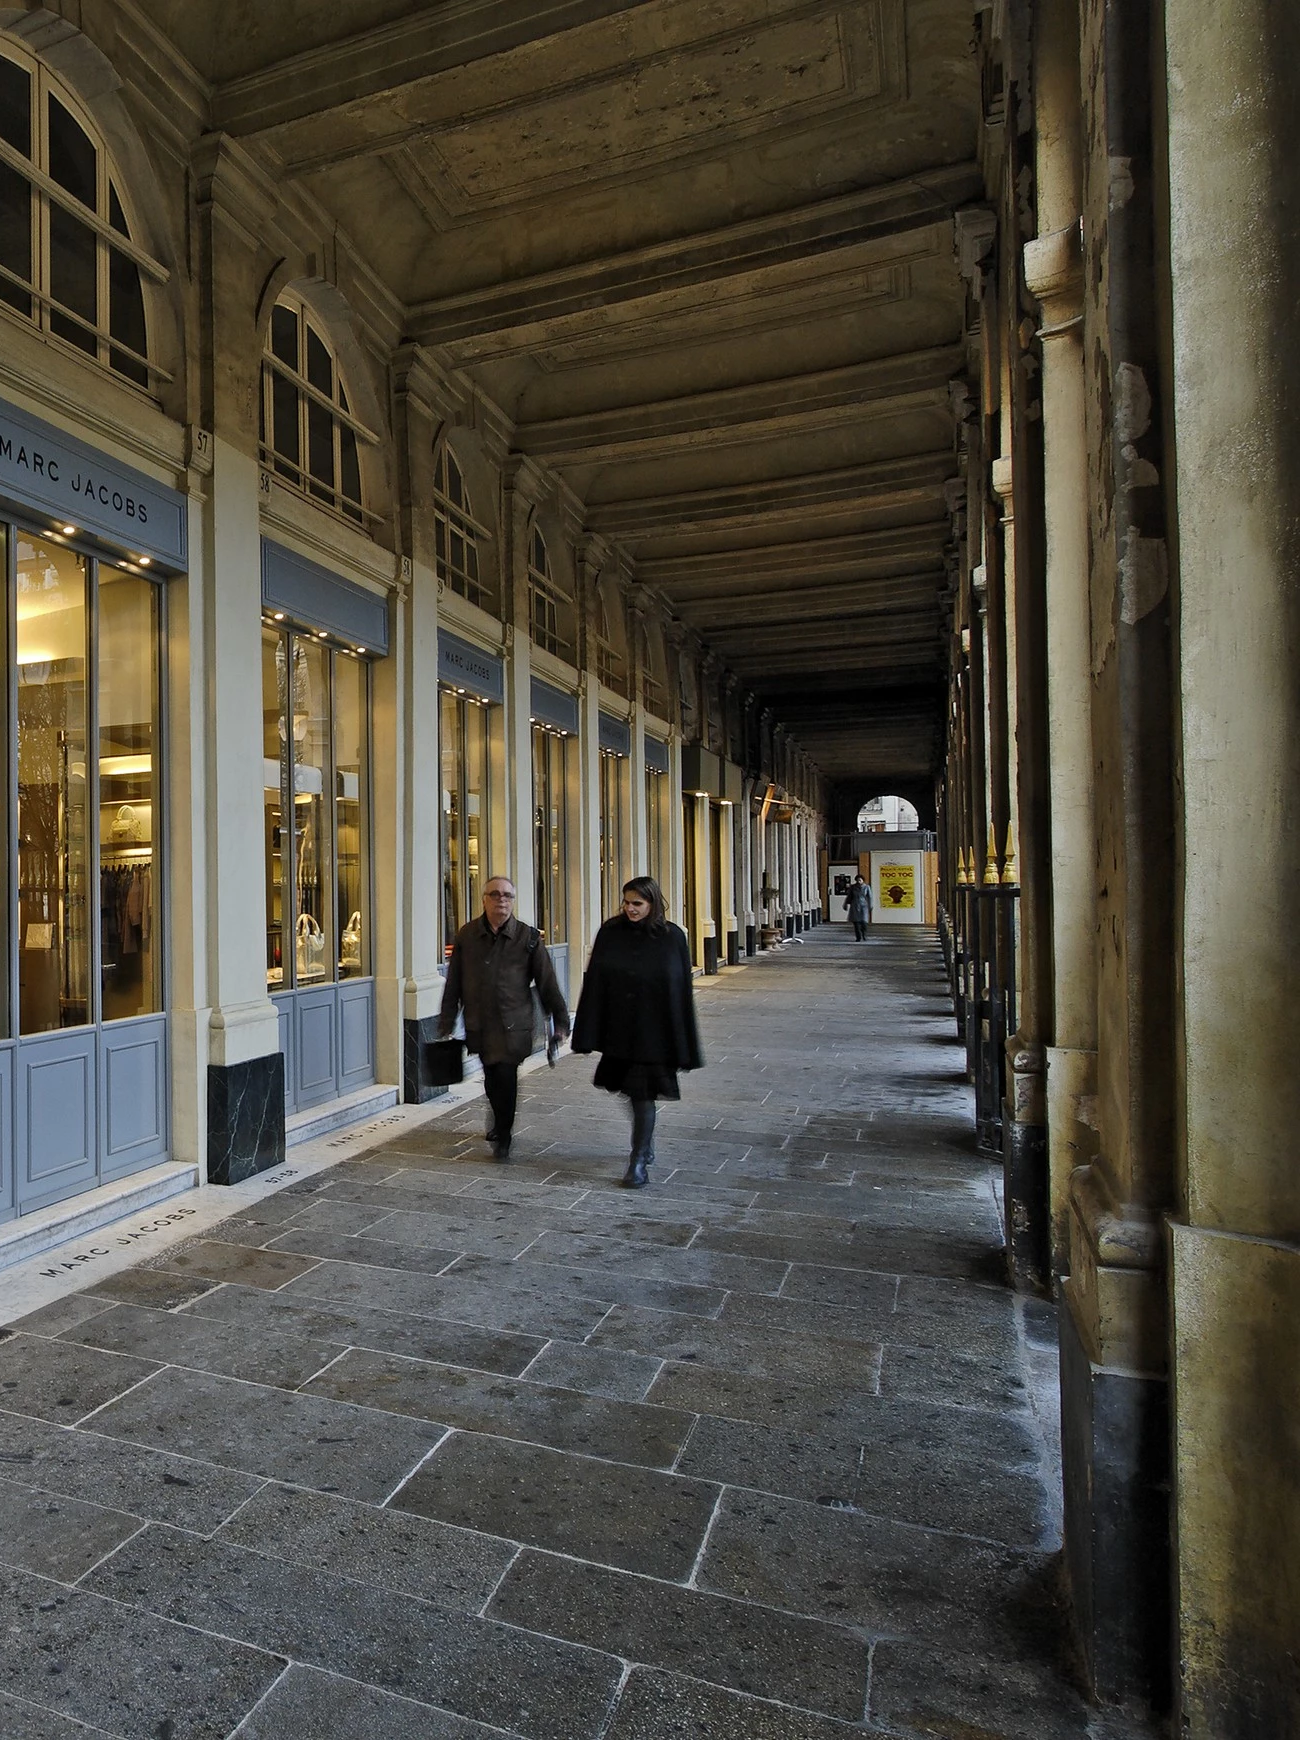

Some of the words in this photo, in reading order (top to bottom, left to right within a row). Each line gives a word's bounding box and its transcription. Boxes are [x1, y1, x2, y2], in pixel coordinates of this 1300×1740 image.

[197, 431, 208, 454] 57
[260, 473, 270, 493] 58
[71, 473, 148, 524] JACOBS
[445, 651, 463, 668] MARC
[465, 661, 490, 680] JACOBS
[327, 1133, 363, 1148] MARC
[39, 1248, 109, 1278] MARC
[117, 1208, 197, 1245] JACOBS
